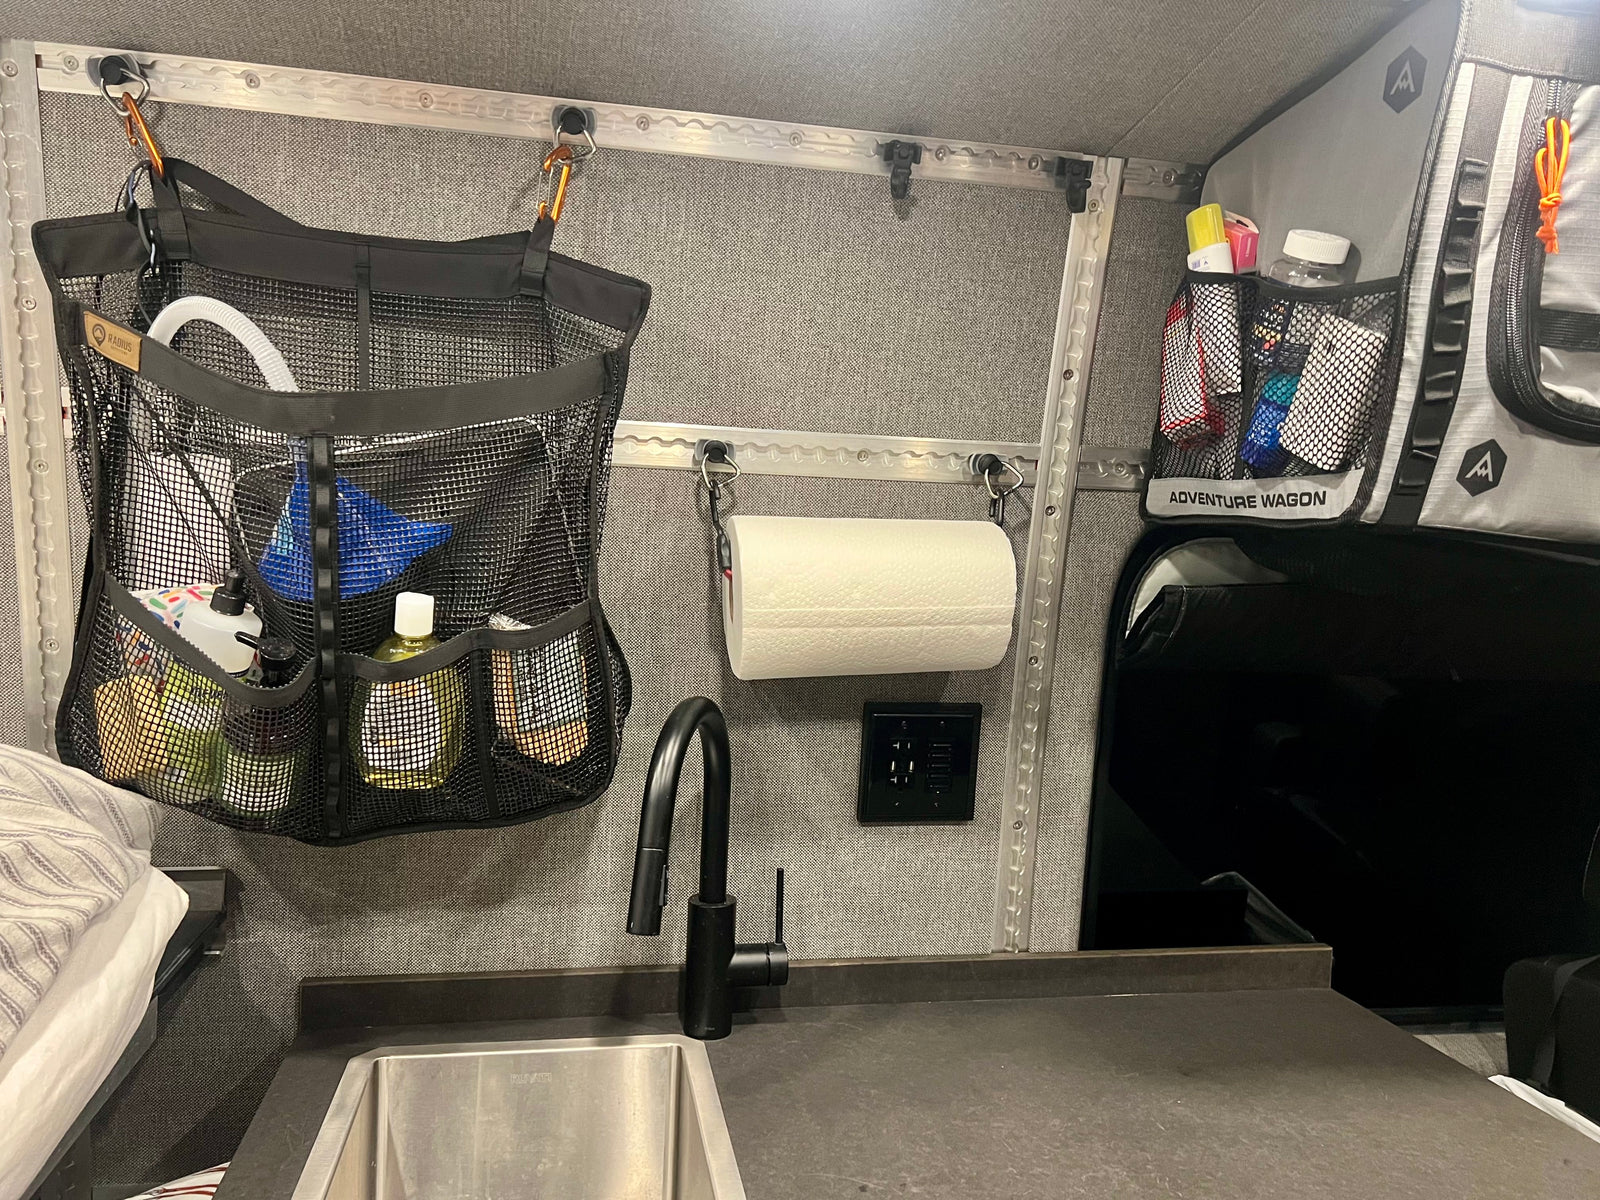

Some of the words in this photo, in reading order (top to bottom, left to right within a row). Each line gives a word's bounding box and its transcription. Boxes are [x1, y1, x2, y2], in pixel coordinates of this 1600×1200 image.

[108, 334, 132, 352] RADIUS
[1169, 491, 1257, 508] ADVENTURE
[1261, 490, 1327, 508] WAGON
